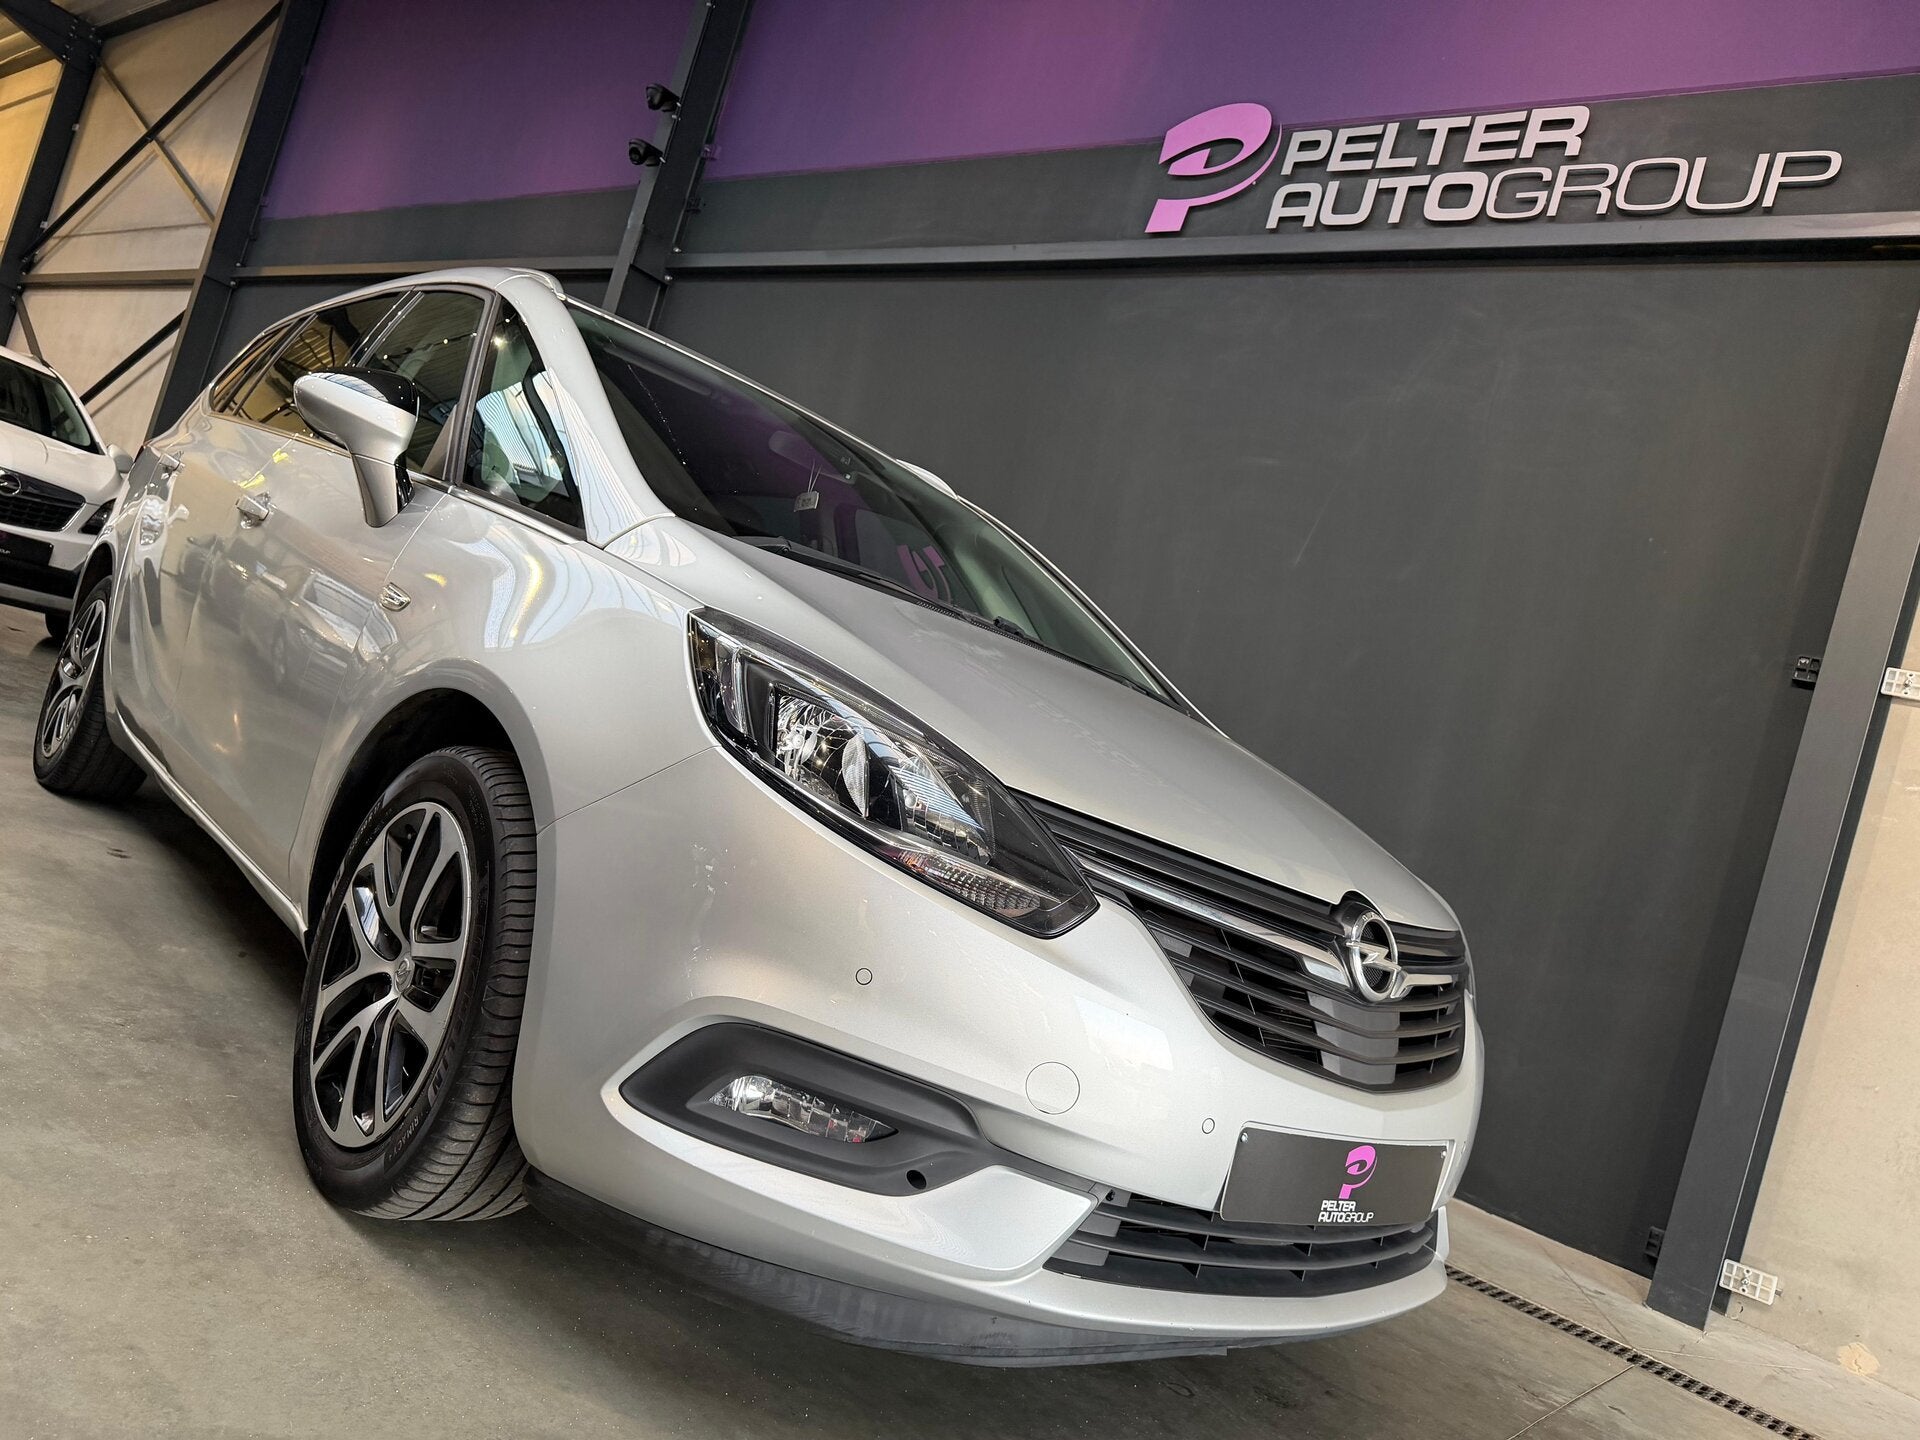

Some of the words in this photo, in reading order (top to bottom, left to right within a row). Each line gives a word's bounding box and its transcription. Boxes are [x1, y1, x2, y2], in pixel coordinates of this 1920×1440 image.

[1280, 105, 1591, 176] PELTER
[1265, 150, 1843, 230] AUTOGROUP
[1318, 1212, 1374, 1222] AUTOGROUP
[1321, 1200, 1356, 1211] PELTER
